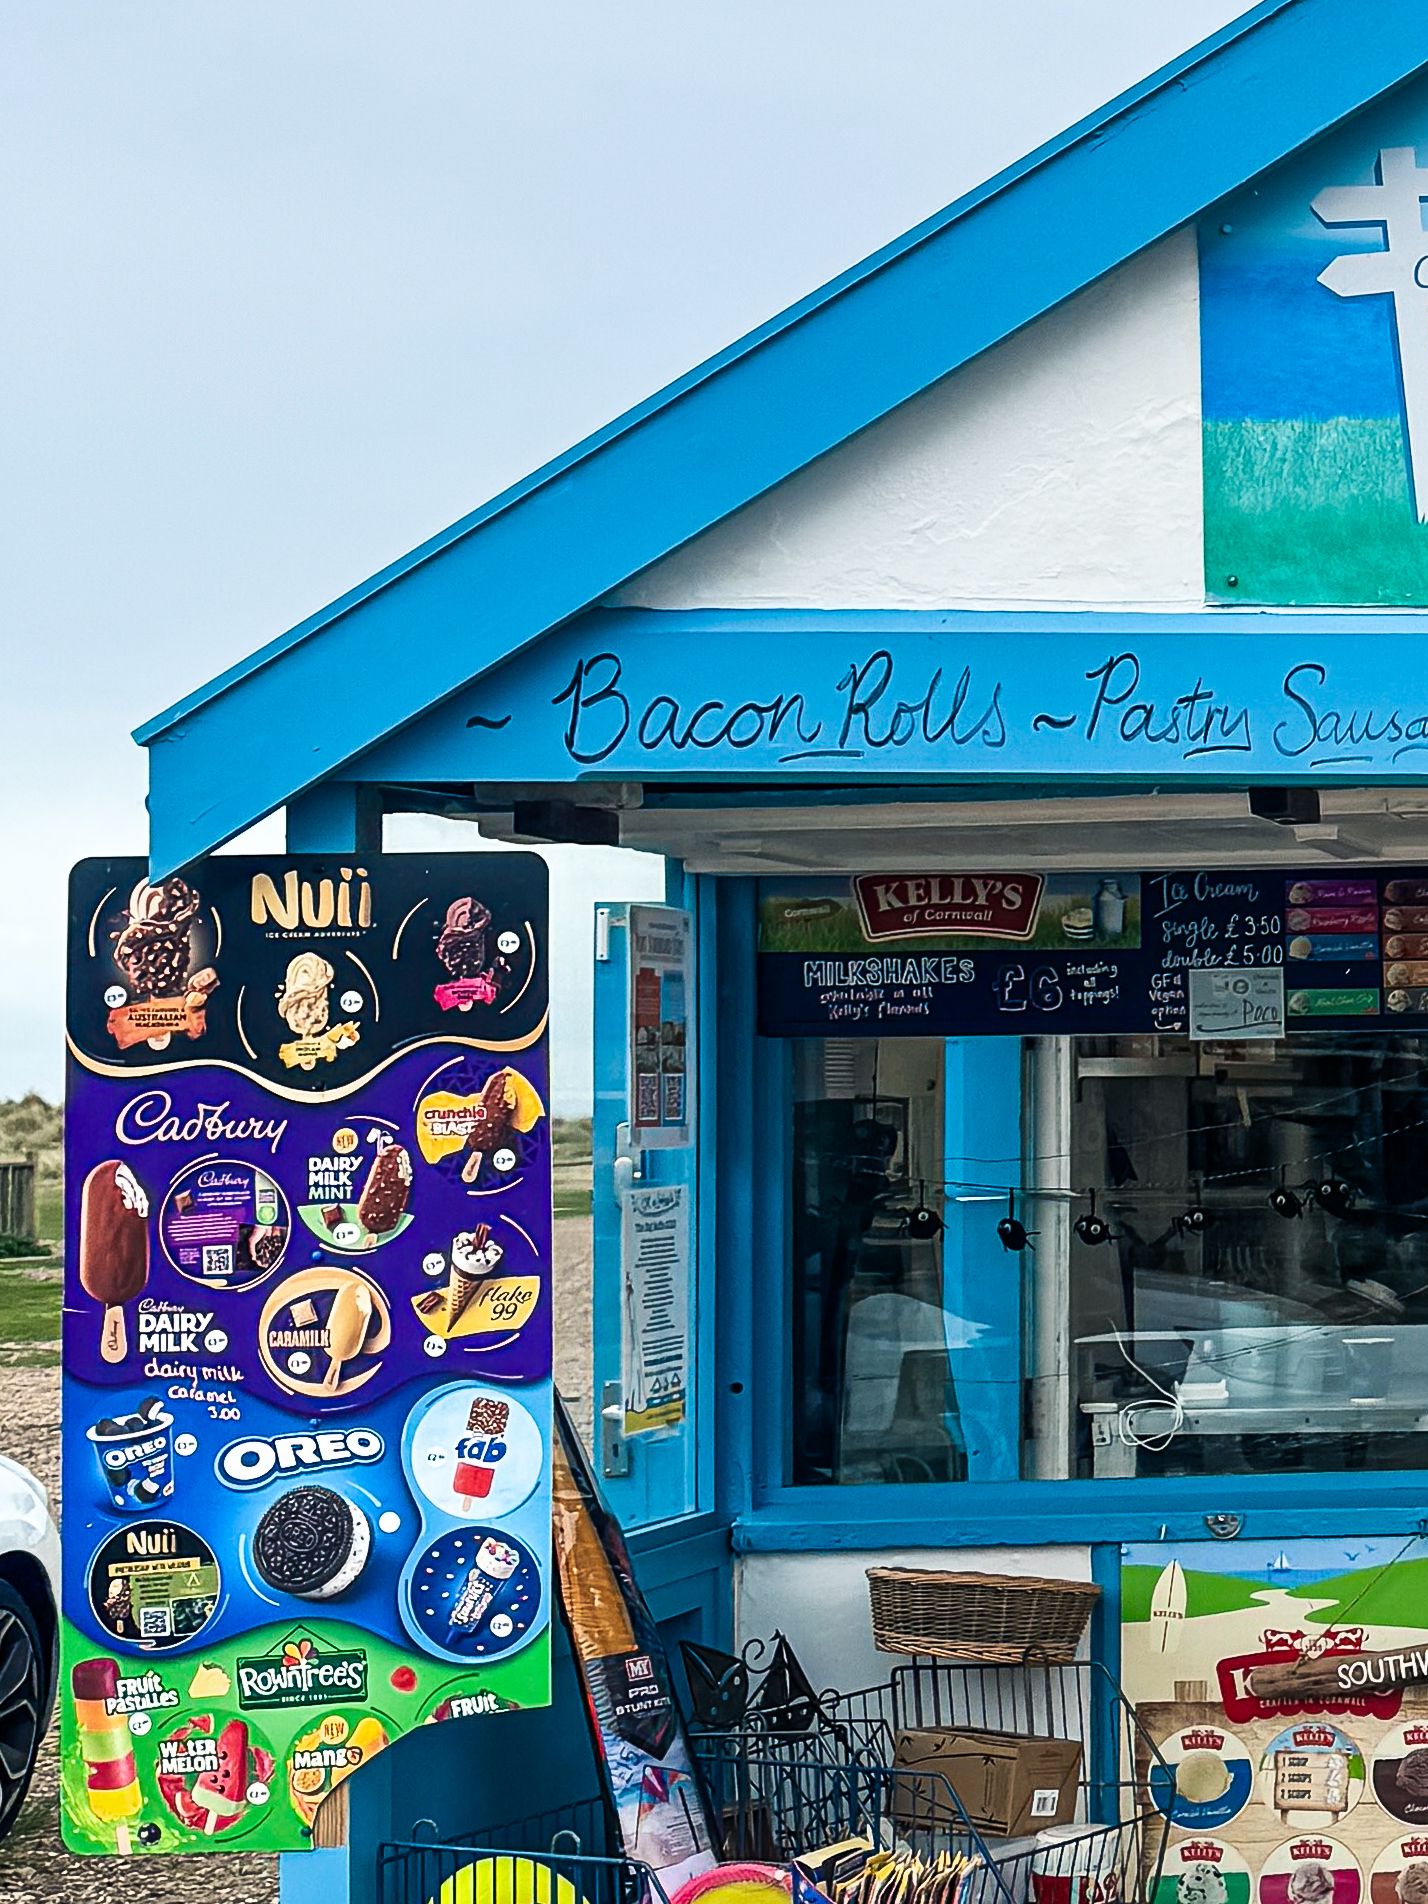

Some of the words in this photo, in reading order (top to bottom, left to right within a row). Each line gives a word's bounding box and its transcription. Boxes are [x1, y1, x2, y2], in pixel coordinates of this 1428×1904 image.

[552, 652, 825, 764] Bacon
[836, 649, 1005, 749] Rolls
[1086, 652, 1250, 754] Pastry
[252, 867, 372, 929] Nuii
[873, 877, 1023, 912] KELLY'S
[1194, 872, 1260, 902] Cream
[904, 910, 919, 923] of
[925, 909, 992, 922] Cornwall
[1162, 916, 1219, 947] single
[1161, 947, 1222, 968] double
[803, 957, 976, 987] MILKSHAKES
[116, 1091, 288, 1153] Cadbury
[308, 1156, 363, 1171] DAIRY
[308, 1172, 353, 1186] MILK
[308, 1186, 353, 1200] MINT
[479, 1285, 532, 1307] flake
[490, 1302, 517, 1320] 99
[138, 1313, 214, 1333] DAIRY
[138, 1333, 200, 1353] MILK
[269, 1328, 331, 1348] CARAMILK
[144, 1357, 198, 1388] dairy
[202, 1365, 245, 1382] milk
[168, 1385, 237, 1403] caramel
[105, 1437, 167, 1468] OREO
[224, 1432, 382, 1482] OREO
[455, 1436, 507, 1463] fab
[628, 1684, 659, 1698] PRO
